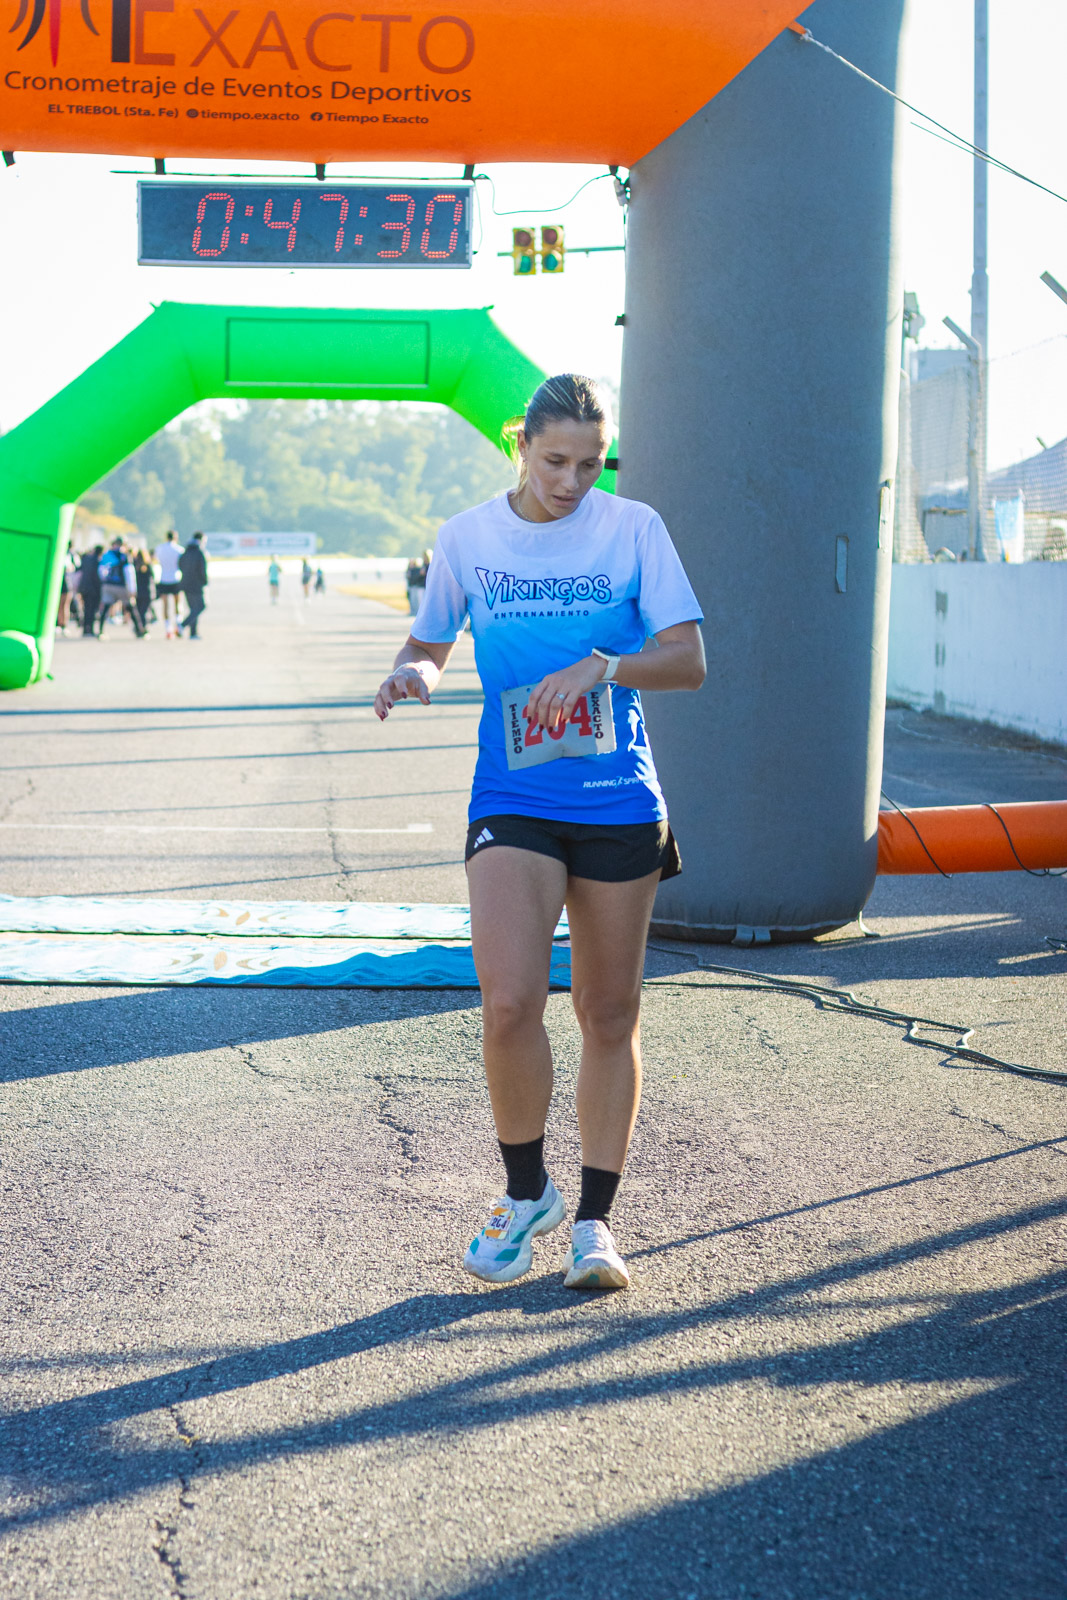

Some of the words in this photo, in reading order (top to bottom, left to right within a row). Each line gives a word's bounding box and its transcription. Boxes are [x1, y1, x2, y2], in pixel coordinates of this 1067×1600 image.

[4, 71, 176, 98] Cronometraje
[184, 76, 215, 96] de
[223, 78, 323, 99] Eventos
[331, 81, 472, 104] Deportivos
[48, 104, 64, 113] EL
[67, 105, 121, 116] TREBOL
[124, 106, 156, 118] (Sta.
[158, 107, 179, 118] Fe)
[201, 109, 300, 121] tiempo.exacto
[326, 112, 379, 124] Tiempo
[383, 114, 429, 124] Exacto
[494, 609, 590, 620] ENTRENAMIENTO
[590, 691, 604, 739] EXACTO
[509, 703, 523, 754] TIEMPO
[583, 779, 617, 788] RUNNING
